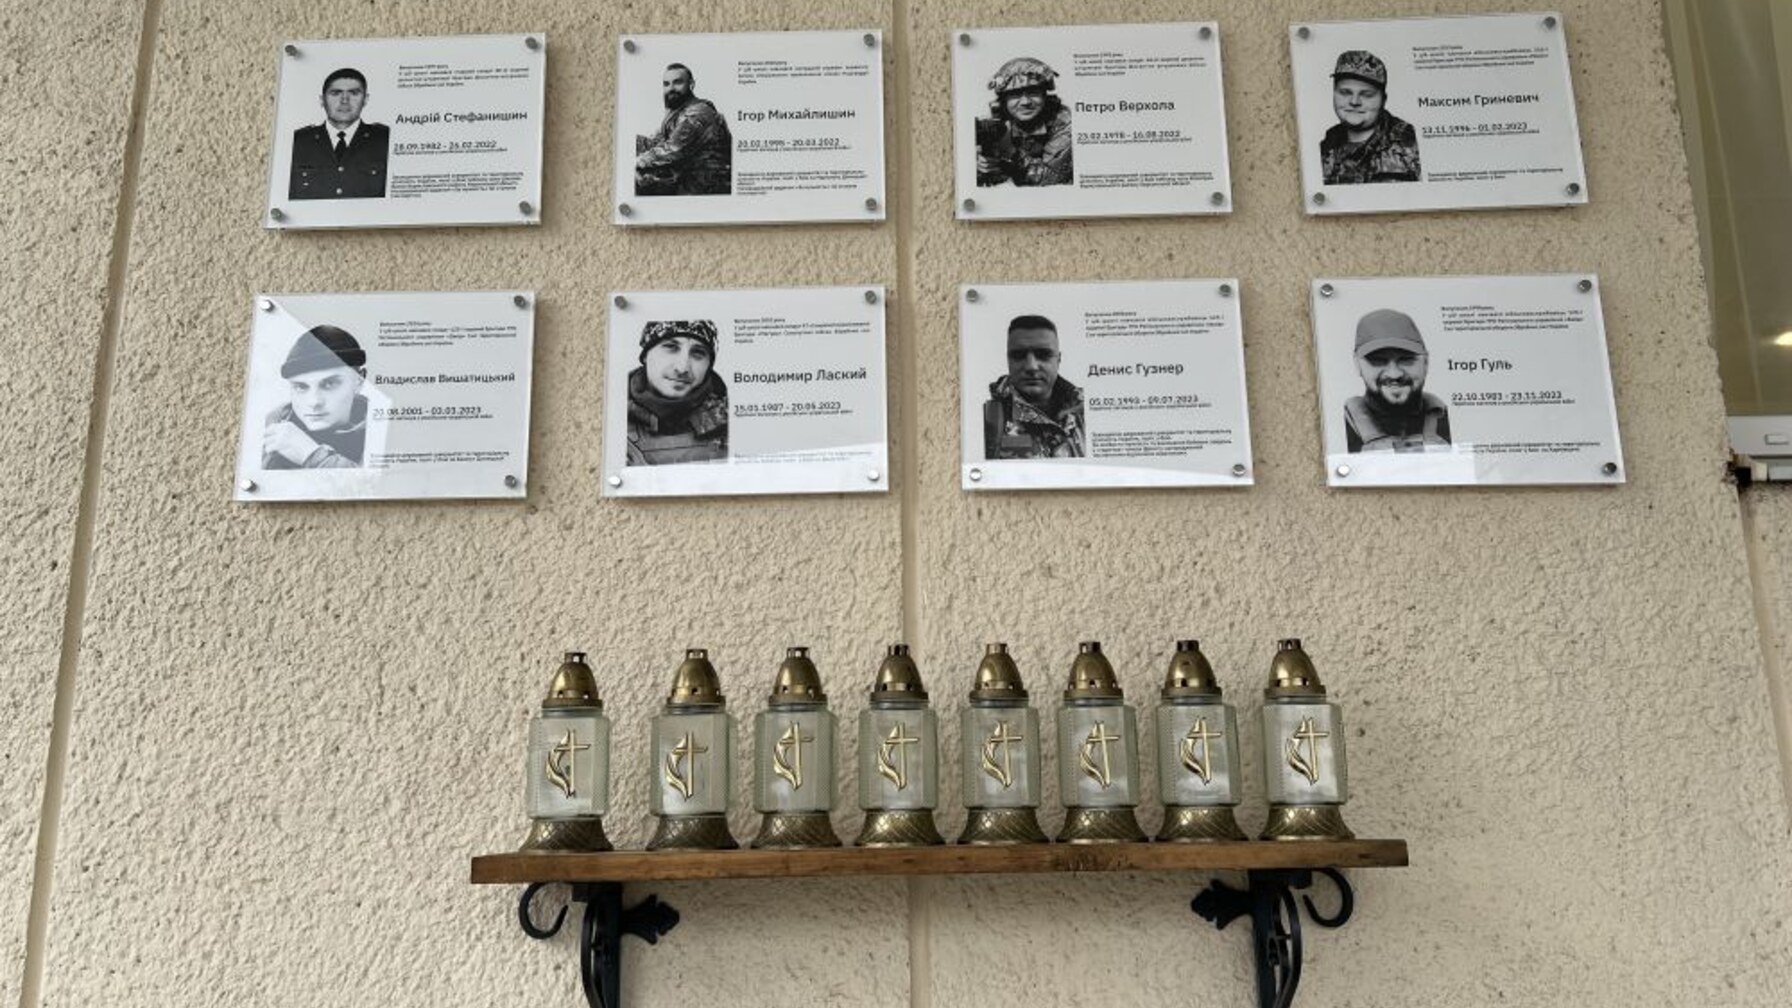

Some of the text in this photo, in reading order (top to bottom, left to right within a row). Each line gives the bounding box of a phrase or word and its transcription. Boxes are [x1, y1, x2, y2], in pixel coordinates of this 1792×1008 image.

[1075, 100, 1176, 114] Петро Верхола
[1418, 94, 1540, 108] Максим Гриневич
[395, 111, 528, 125] Андрій Стефанишин
[737, 108, 856, 122] Ігор Михайлишин
[1087, 363, 1184, 377] Денис Гузнер
[1447, 358, 1513, 372] Ігор Гуль
[375, 372, 516, 385] Владислав Вишатицький
[733, 367, 867, 384] Володимир Лаский
